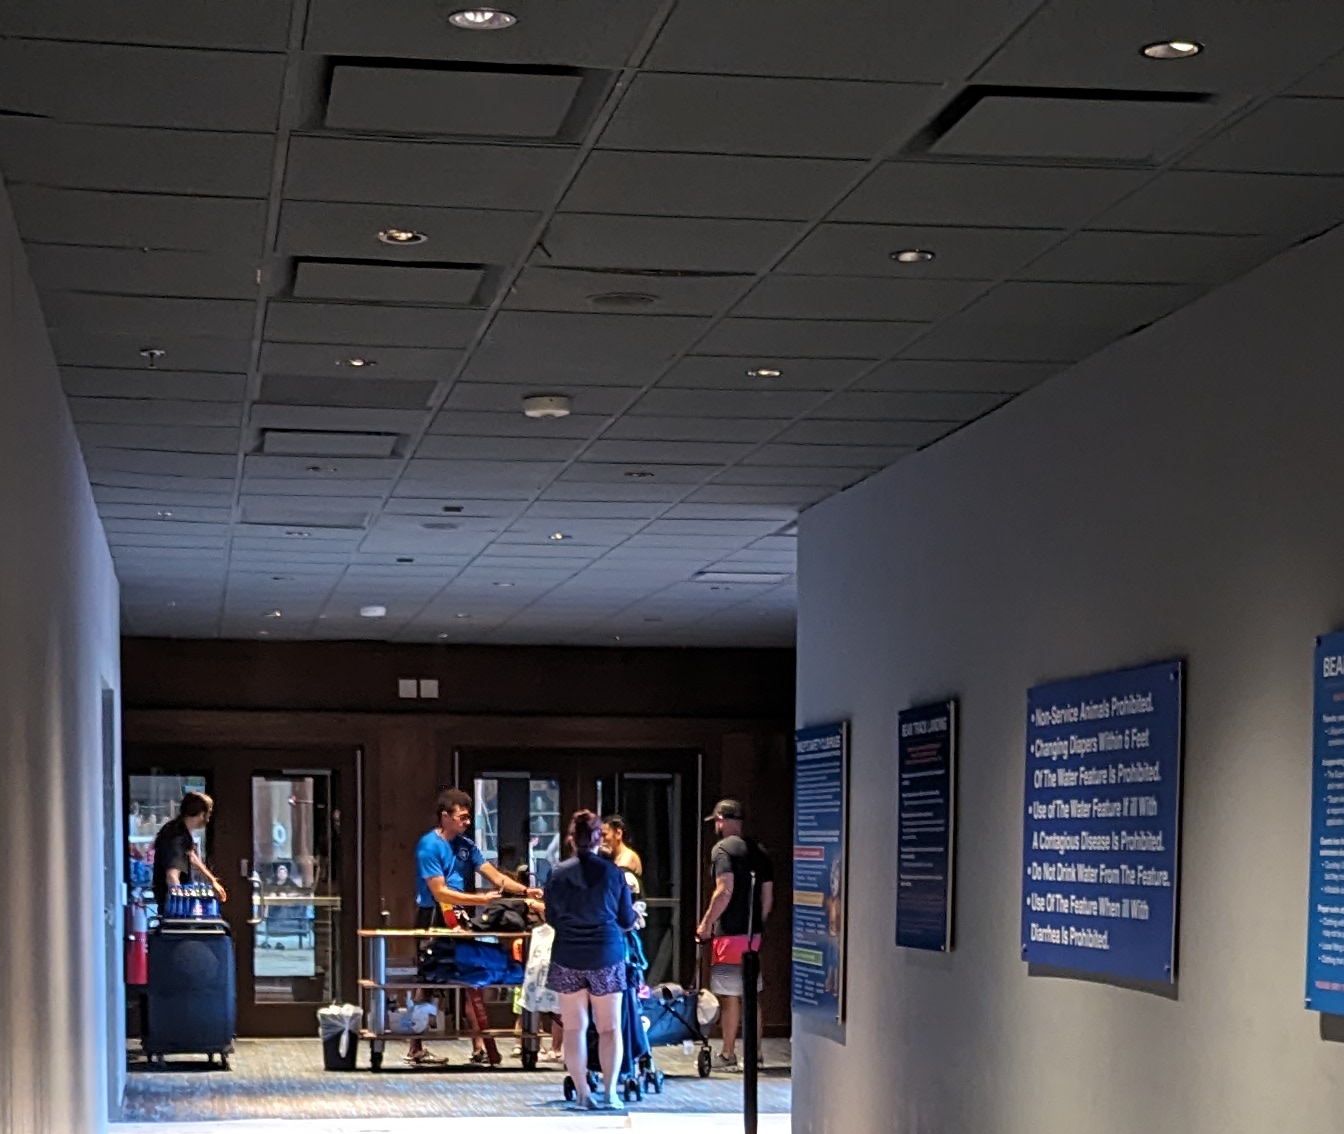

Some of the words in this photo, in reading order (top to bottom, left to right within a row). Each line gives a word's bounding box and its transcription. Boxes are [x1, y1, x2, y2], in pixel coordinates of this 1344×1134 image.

[1035, 704, 1078, 727] Non-Service
[1079, 700, 1110, 721] Animals
[1111, 692, 1154, 716] Prohibited.
[1035, 736, 1068, 761] Changing
[1069, 735, 1097, 758] Diapers
[1124, 729, 1130, 749] 6
[1131, 728, 1149, 749] Feet
[1043, 769, 1056, 788] The
[1057, 768, 1078, 787] Water
[1079, 766, 1108, 785] Feature
[1109, 764, 1116, 784] Is
[1117, 760, 1162, 784] Prohibited.
[1033, 800, 1046, 820] Use
[1053, 799, 1069, 819] The
[1070, 799, 1091, 818] Water
[1092, 798, 1121, 818] Feature
[1032, 831, 1038, 850] A
[1039, 830, 1080, 855] Contagious
[1081, 831, 1111, 851] Disease
[1111, 830, 1119, 851] Is
[1120, 830, 1166, 852] Prohibited.
[1031, 861, 1042, 881] Do
[1043, 862, 1056, 881] Not
[1057, 862, 1076, 882] Drink
[1077, 863, 1098, 883] Water
[1099, 863, 1120, 884] From
[1120, 864, 1136, 885] The
[1137, 865, 1171, 887] Feature.
[1031, 892, 1045, 912] Use
[1054, 893, 1069, 914] The
[1070, 894, 1098, 916] Feature
[1098, 896, 1121, 918] When
[1030, 922, 1060, 944] Diarrhea
[1061, 925, 1068, 945] Is
[1069, 926, 1110, 949] Prohibited.
